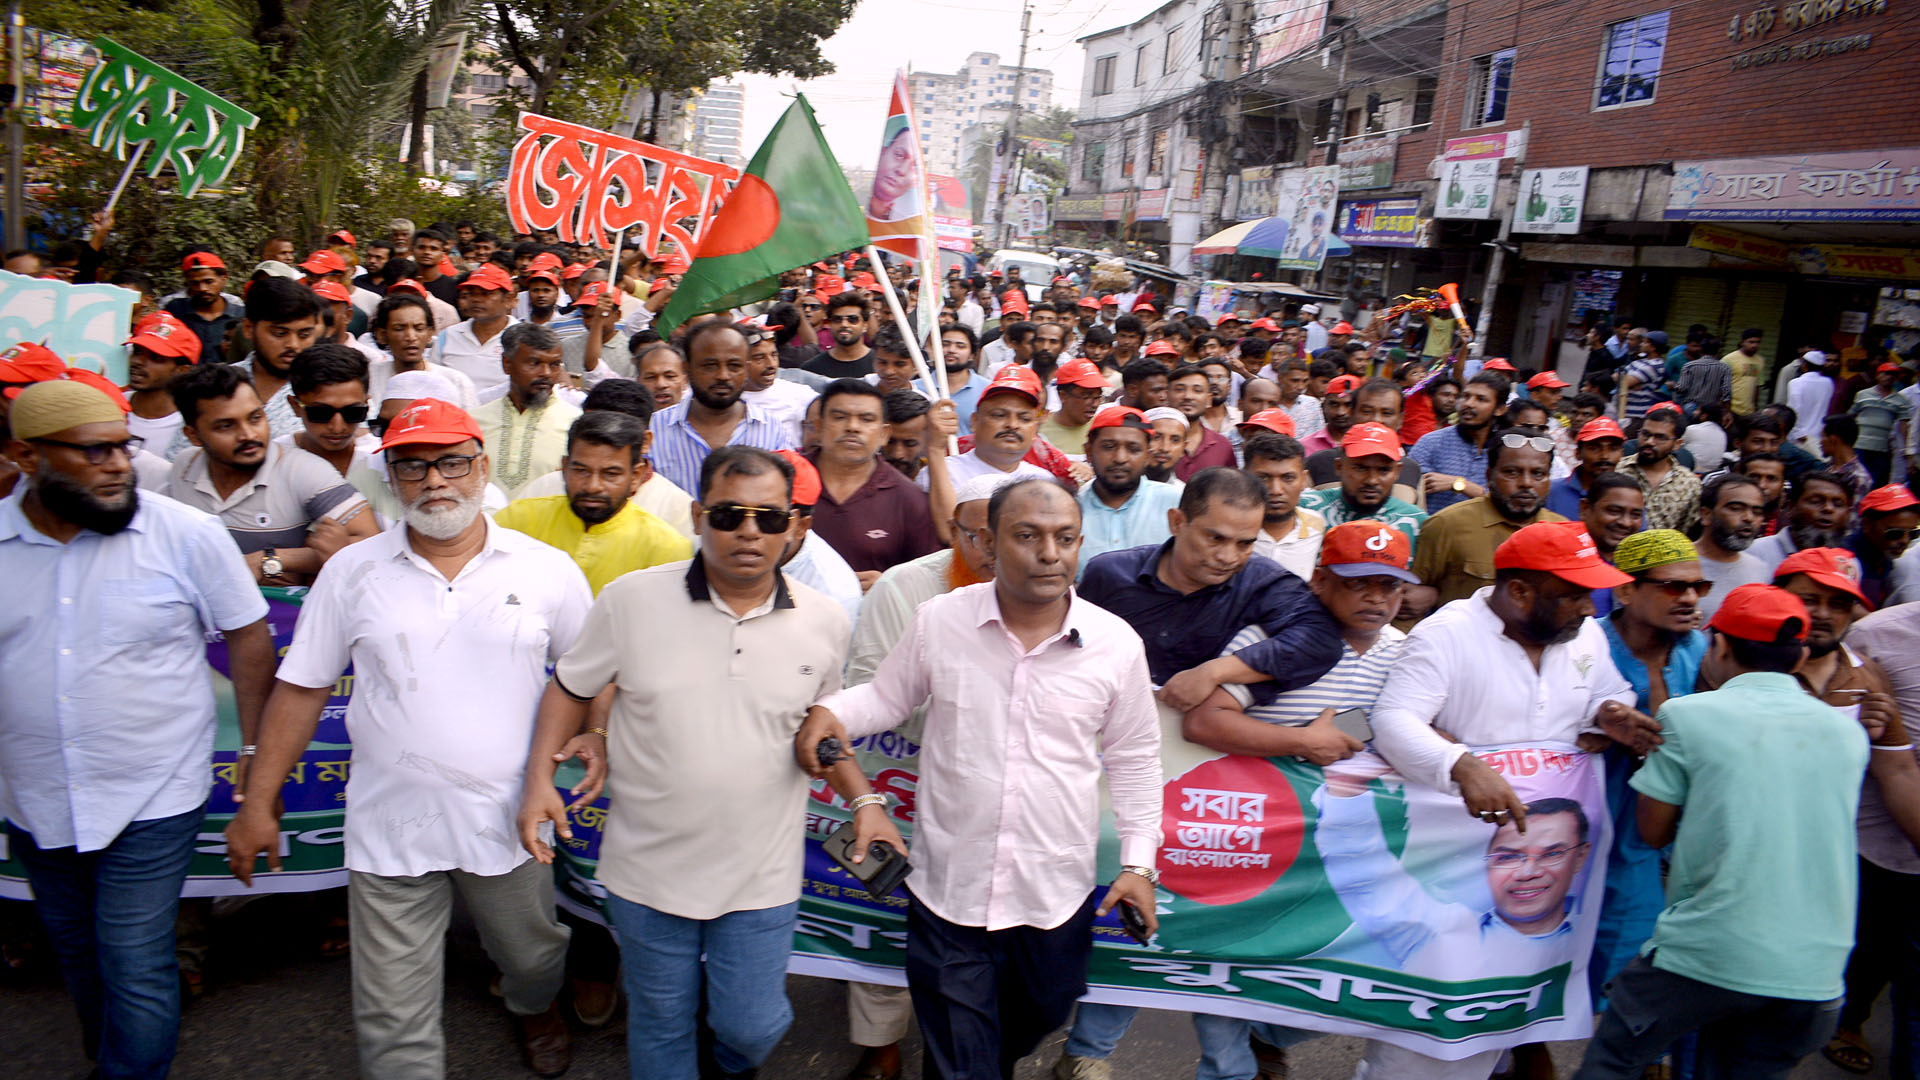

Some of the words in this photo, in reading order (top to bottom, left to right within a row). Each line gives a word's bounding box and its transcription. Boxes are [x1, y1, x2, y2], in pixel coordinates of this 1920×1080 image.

[1715, 173, 1787, 200] সাহা
[1798, 160, 1901, 198] ফার্মা
[1181, 787, 1267, 823] সবার
[1176, 820, 1265, 852] আগে
[1164, 847, 1271, 869] বাংলাদেশ
[1119, 957, 1553, 1023] যুবদল
